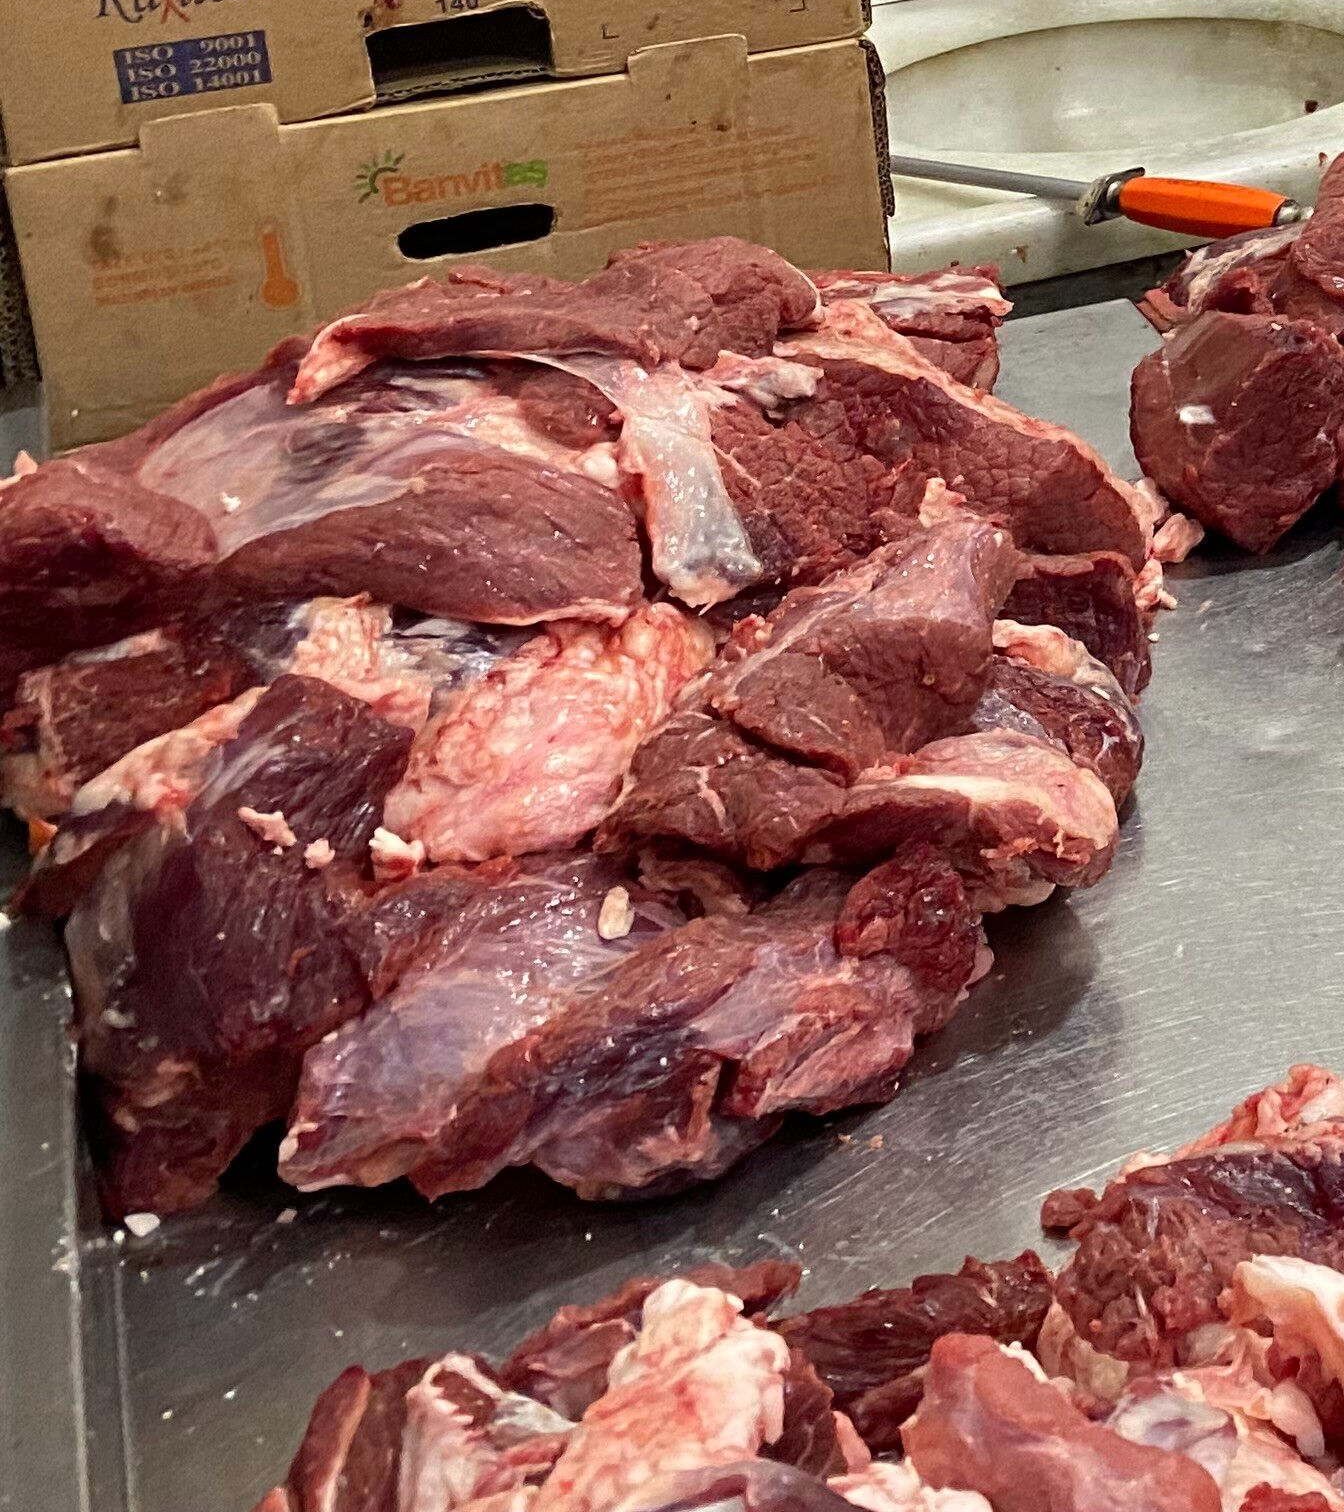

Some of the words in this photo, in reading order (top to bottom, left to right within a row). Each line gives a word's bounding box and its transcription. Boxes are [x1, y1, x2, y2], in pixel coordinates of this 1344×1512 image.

[124, 45, 173, 65] ISO
[200, 33, 257, 54] 9001
[127, 63, 177, 83] ISO
[189, 50, 262, 74] 22000
[131, 81, 180, 101] ISO
[194, 69, 263, 91] 14001
